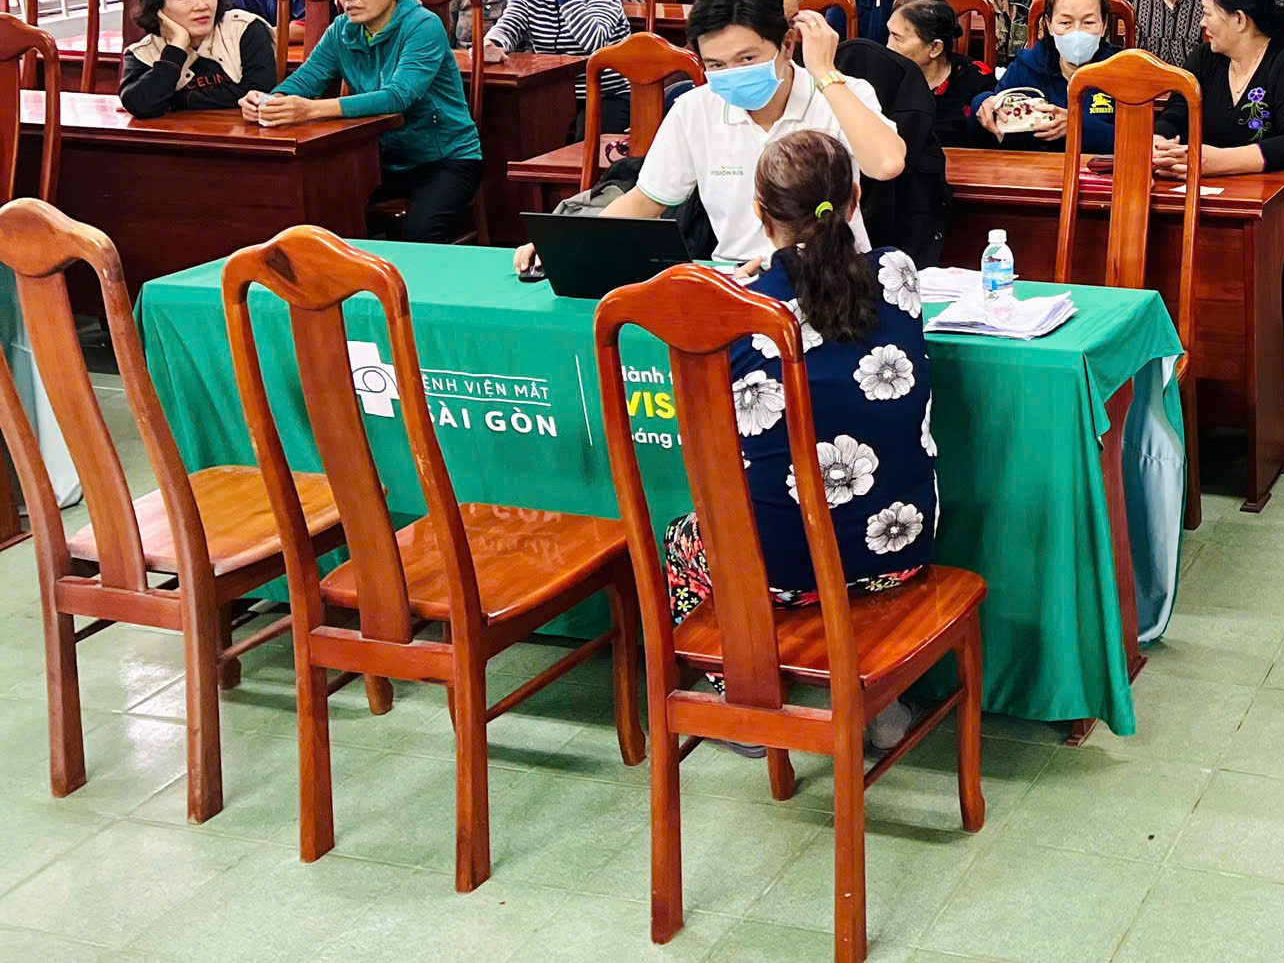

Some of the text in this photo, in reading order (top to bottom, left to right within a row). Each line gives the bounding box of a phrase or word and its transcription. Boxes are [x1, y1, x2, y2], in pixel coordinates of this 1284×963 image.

[186, 73, 232, 89] CELIN
[421, 373, 458, 392] ỆNH
[463, 379, 507, 397] VIỆN
[626, 391, 675, 419] VIS
[484, 406, 558, 437] GÒN
[631, 427, 673, 449] áng
